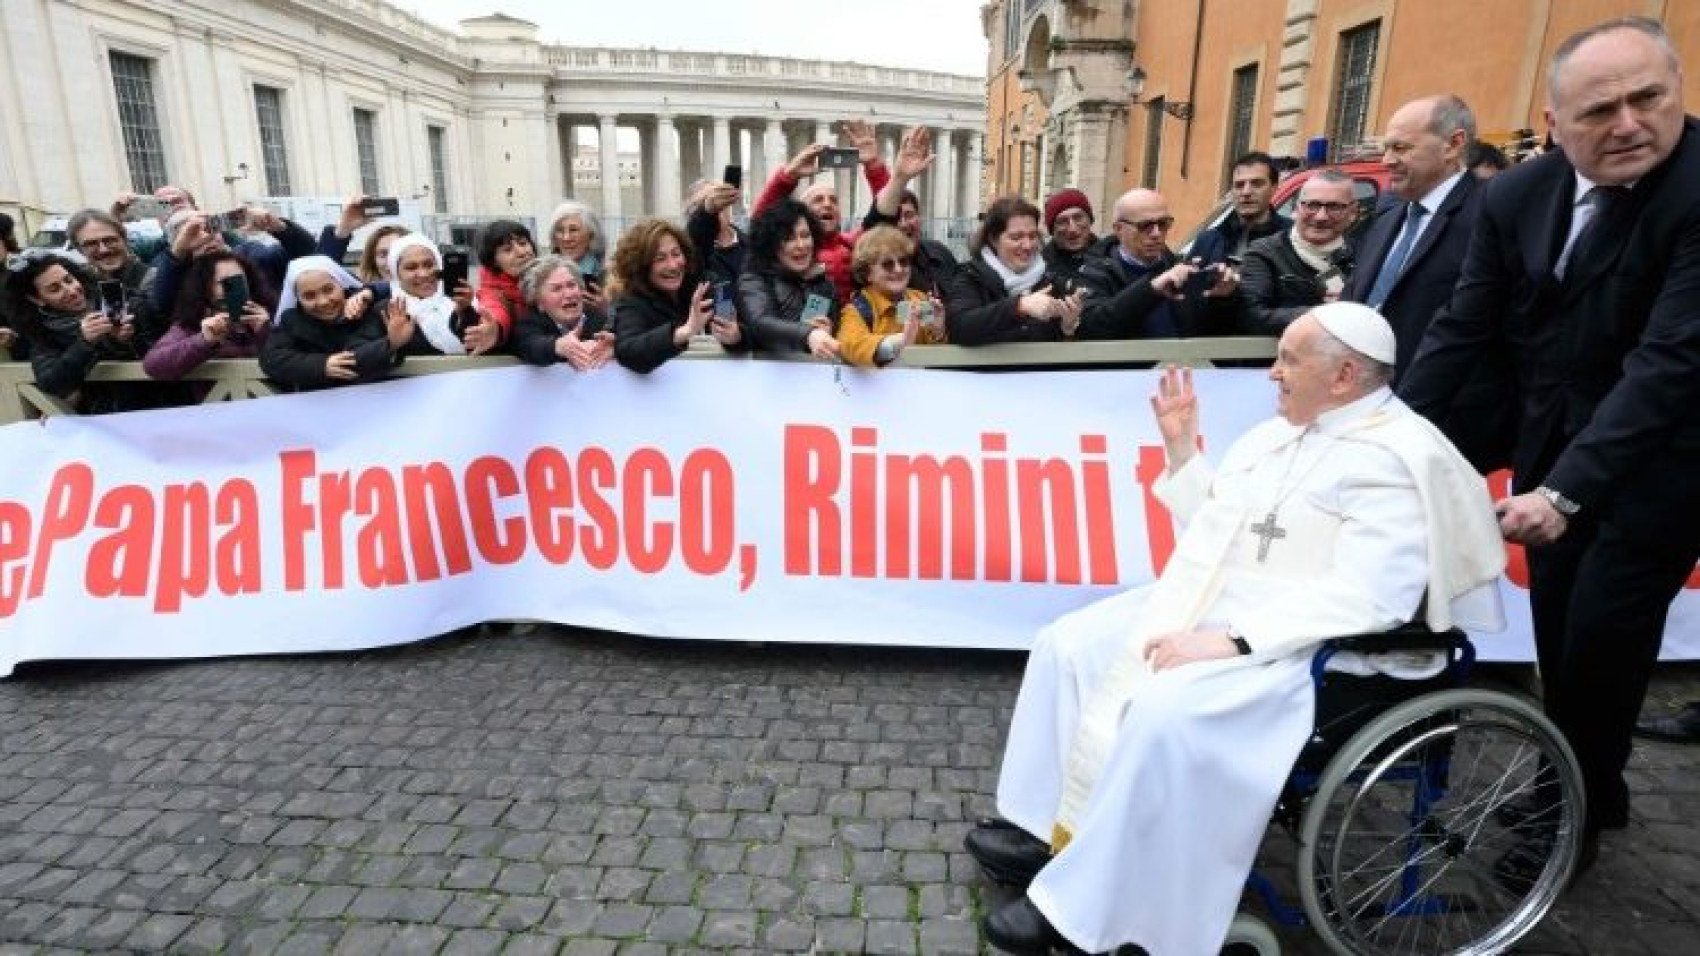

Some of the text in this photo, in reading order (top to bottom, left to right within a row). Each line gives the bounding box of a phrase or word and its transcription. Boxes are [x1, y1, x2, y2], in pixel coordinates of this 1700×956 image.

[28, 462, 262, 614] Papa
[280, 446, 758, 590] Francesco,
[783, 425, 1118, 586] Rimini
